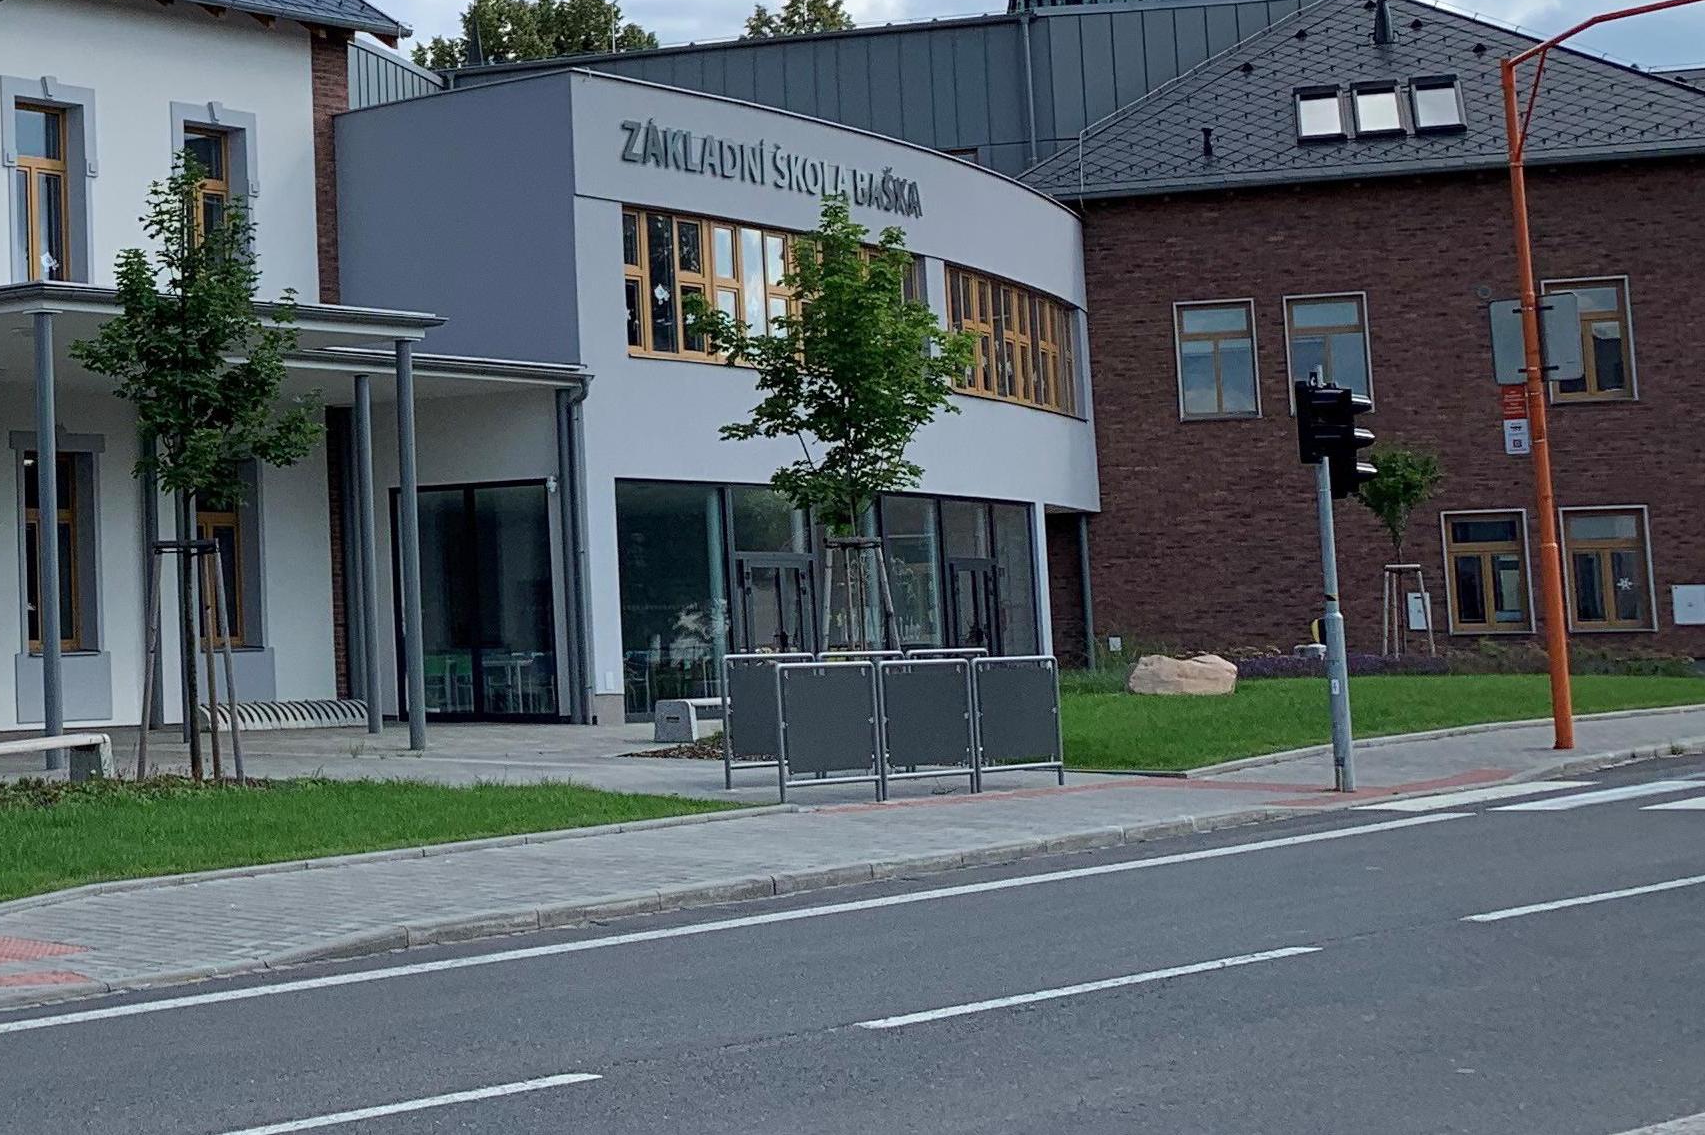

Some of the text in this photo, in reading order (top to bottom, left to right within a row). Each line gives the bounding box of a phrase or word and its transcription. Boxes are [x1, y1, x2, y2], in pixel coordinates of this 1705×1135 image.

[621, 118, 923, 218] ZÁKLADNÍ ŠKOLA BAŠKA
